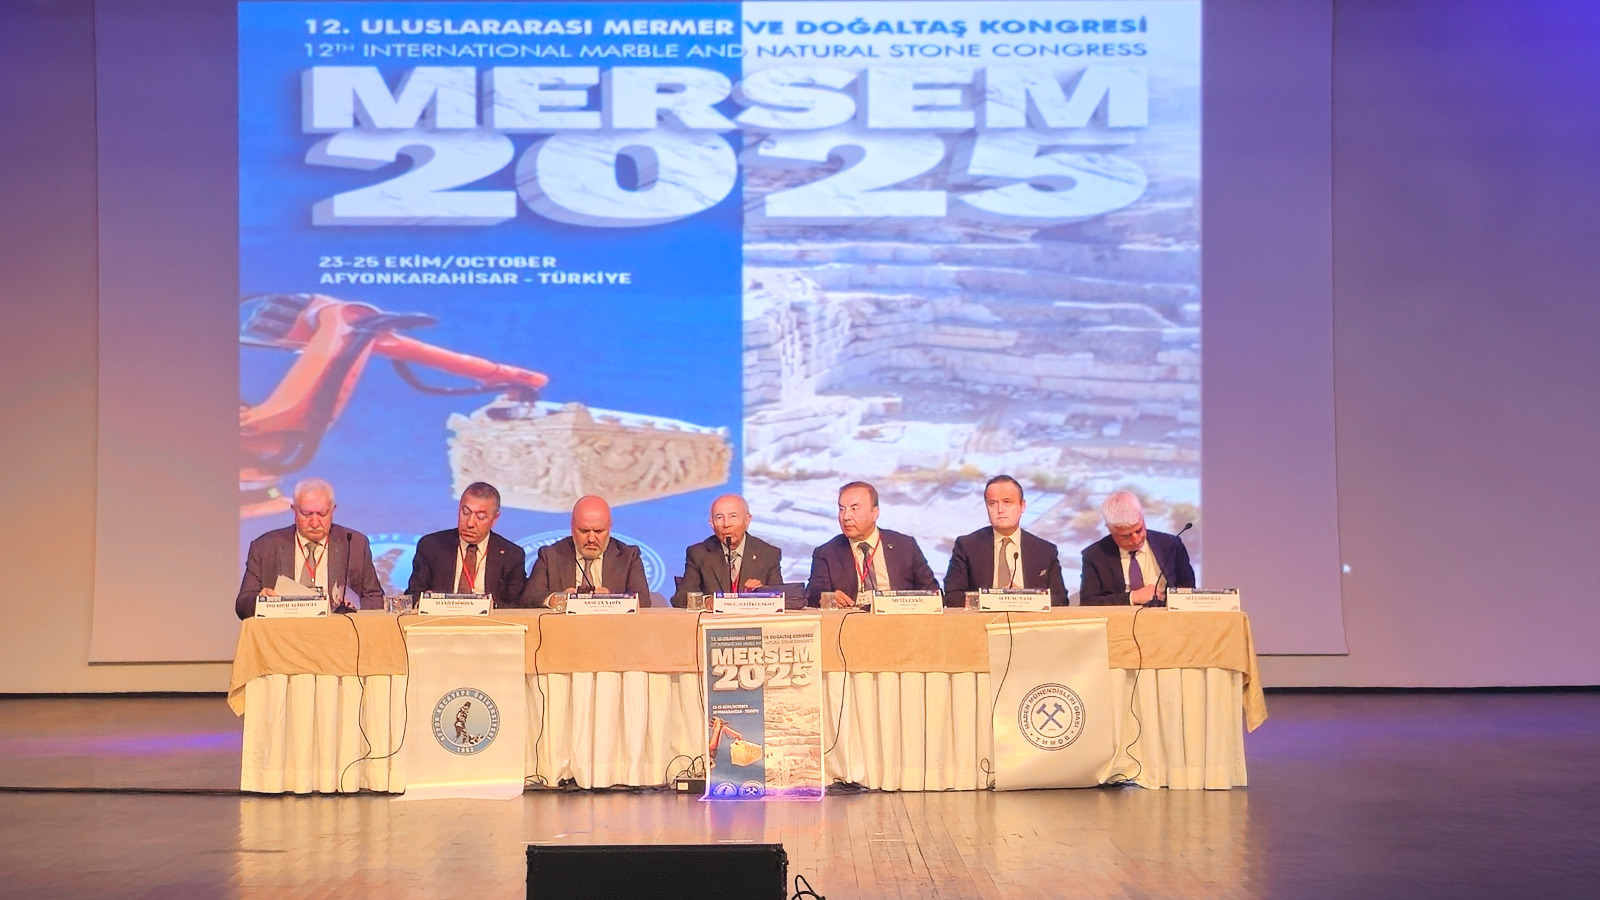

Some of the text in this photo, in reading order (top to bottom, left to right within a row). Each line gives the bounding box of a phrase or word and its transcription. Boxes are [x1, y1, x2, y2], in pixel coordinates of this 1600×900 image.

[305, 16, 1148, 38] 12. ULUSLARARASI MERMER VE DOĞALTAŞ KONGRESİ
[363, 43, 572, 58] INTERNATIONAL
[579, 44, 679, 58] MARBLE
[686, 44, 748, 58] AND
[757, 45, 880, 58] NATURAL
[890, 44, 981, 58] STONE
[992, 43, 1148, 57] CONGRESS
[302, 66, 1149, 133] MERSEM
[304, 130, 1149, 226] 2025
[318, 254, 557, 269] 23-25 EKİM/OCTOBER
[319, 271, 519, 285] AFYONKARAHİSAR
[537, 270, 633, 285] TÜRKİYE
[711, 647, 814, 667] MERSEM
[712, 661, 814, 691] 2025
[1023, 704, 1031, 730] MADEN
